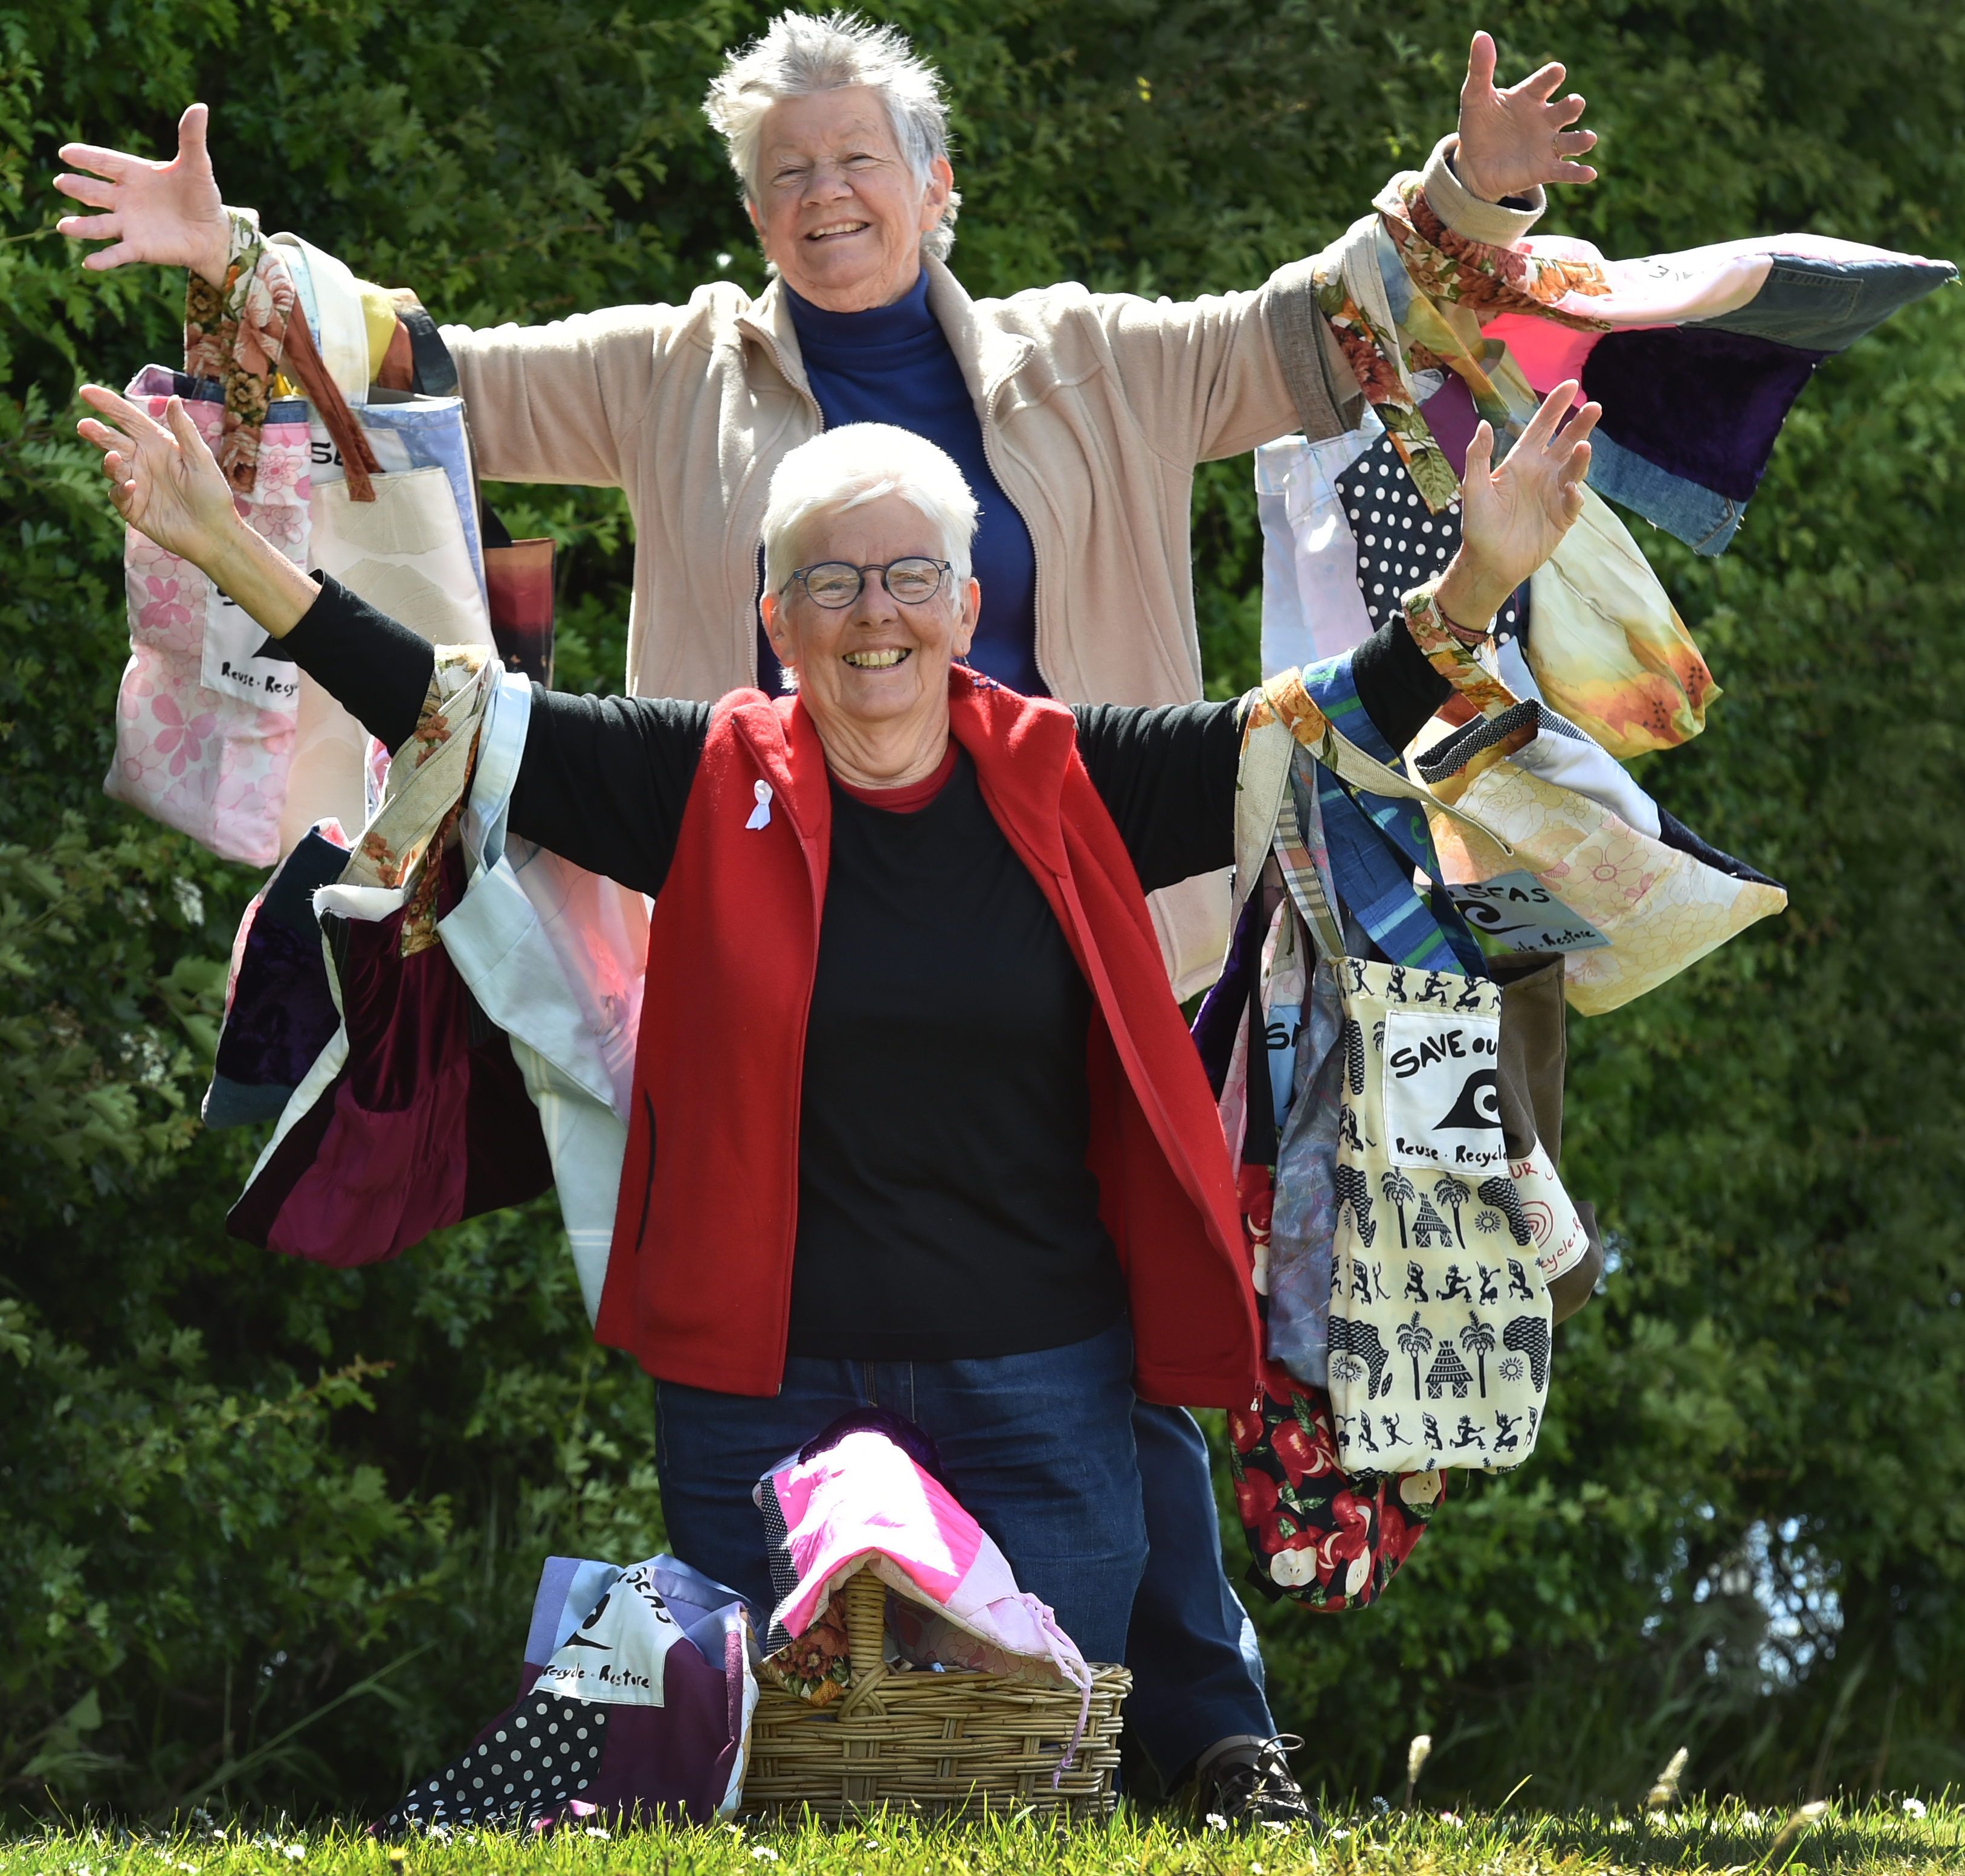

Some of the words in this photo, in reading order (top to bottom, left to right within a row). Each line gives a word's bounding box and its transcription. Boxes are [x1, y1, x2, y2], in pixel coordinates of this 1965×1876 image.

[221, 661, 254, 686] Reuse
[1463, 884, 1550, 903] SEAS
[1541, 929, 1596, 947] Restore
[1390, 1029, 1467, 1078] SAVE
[1396, 1137, 1439, 1161] Reuse
